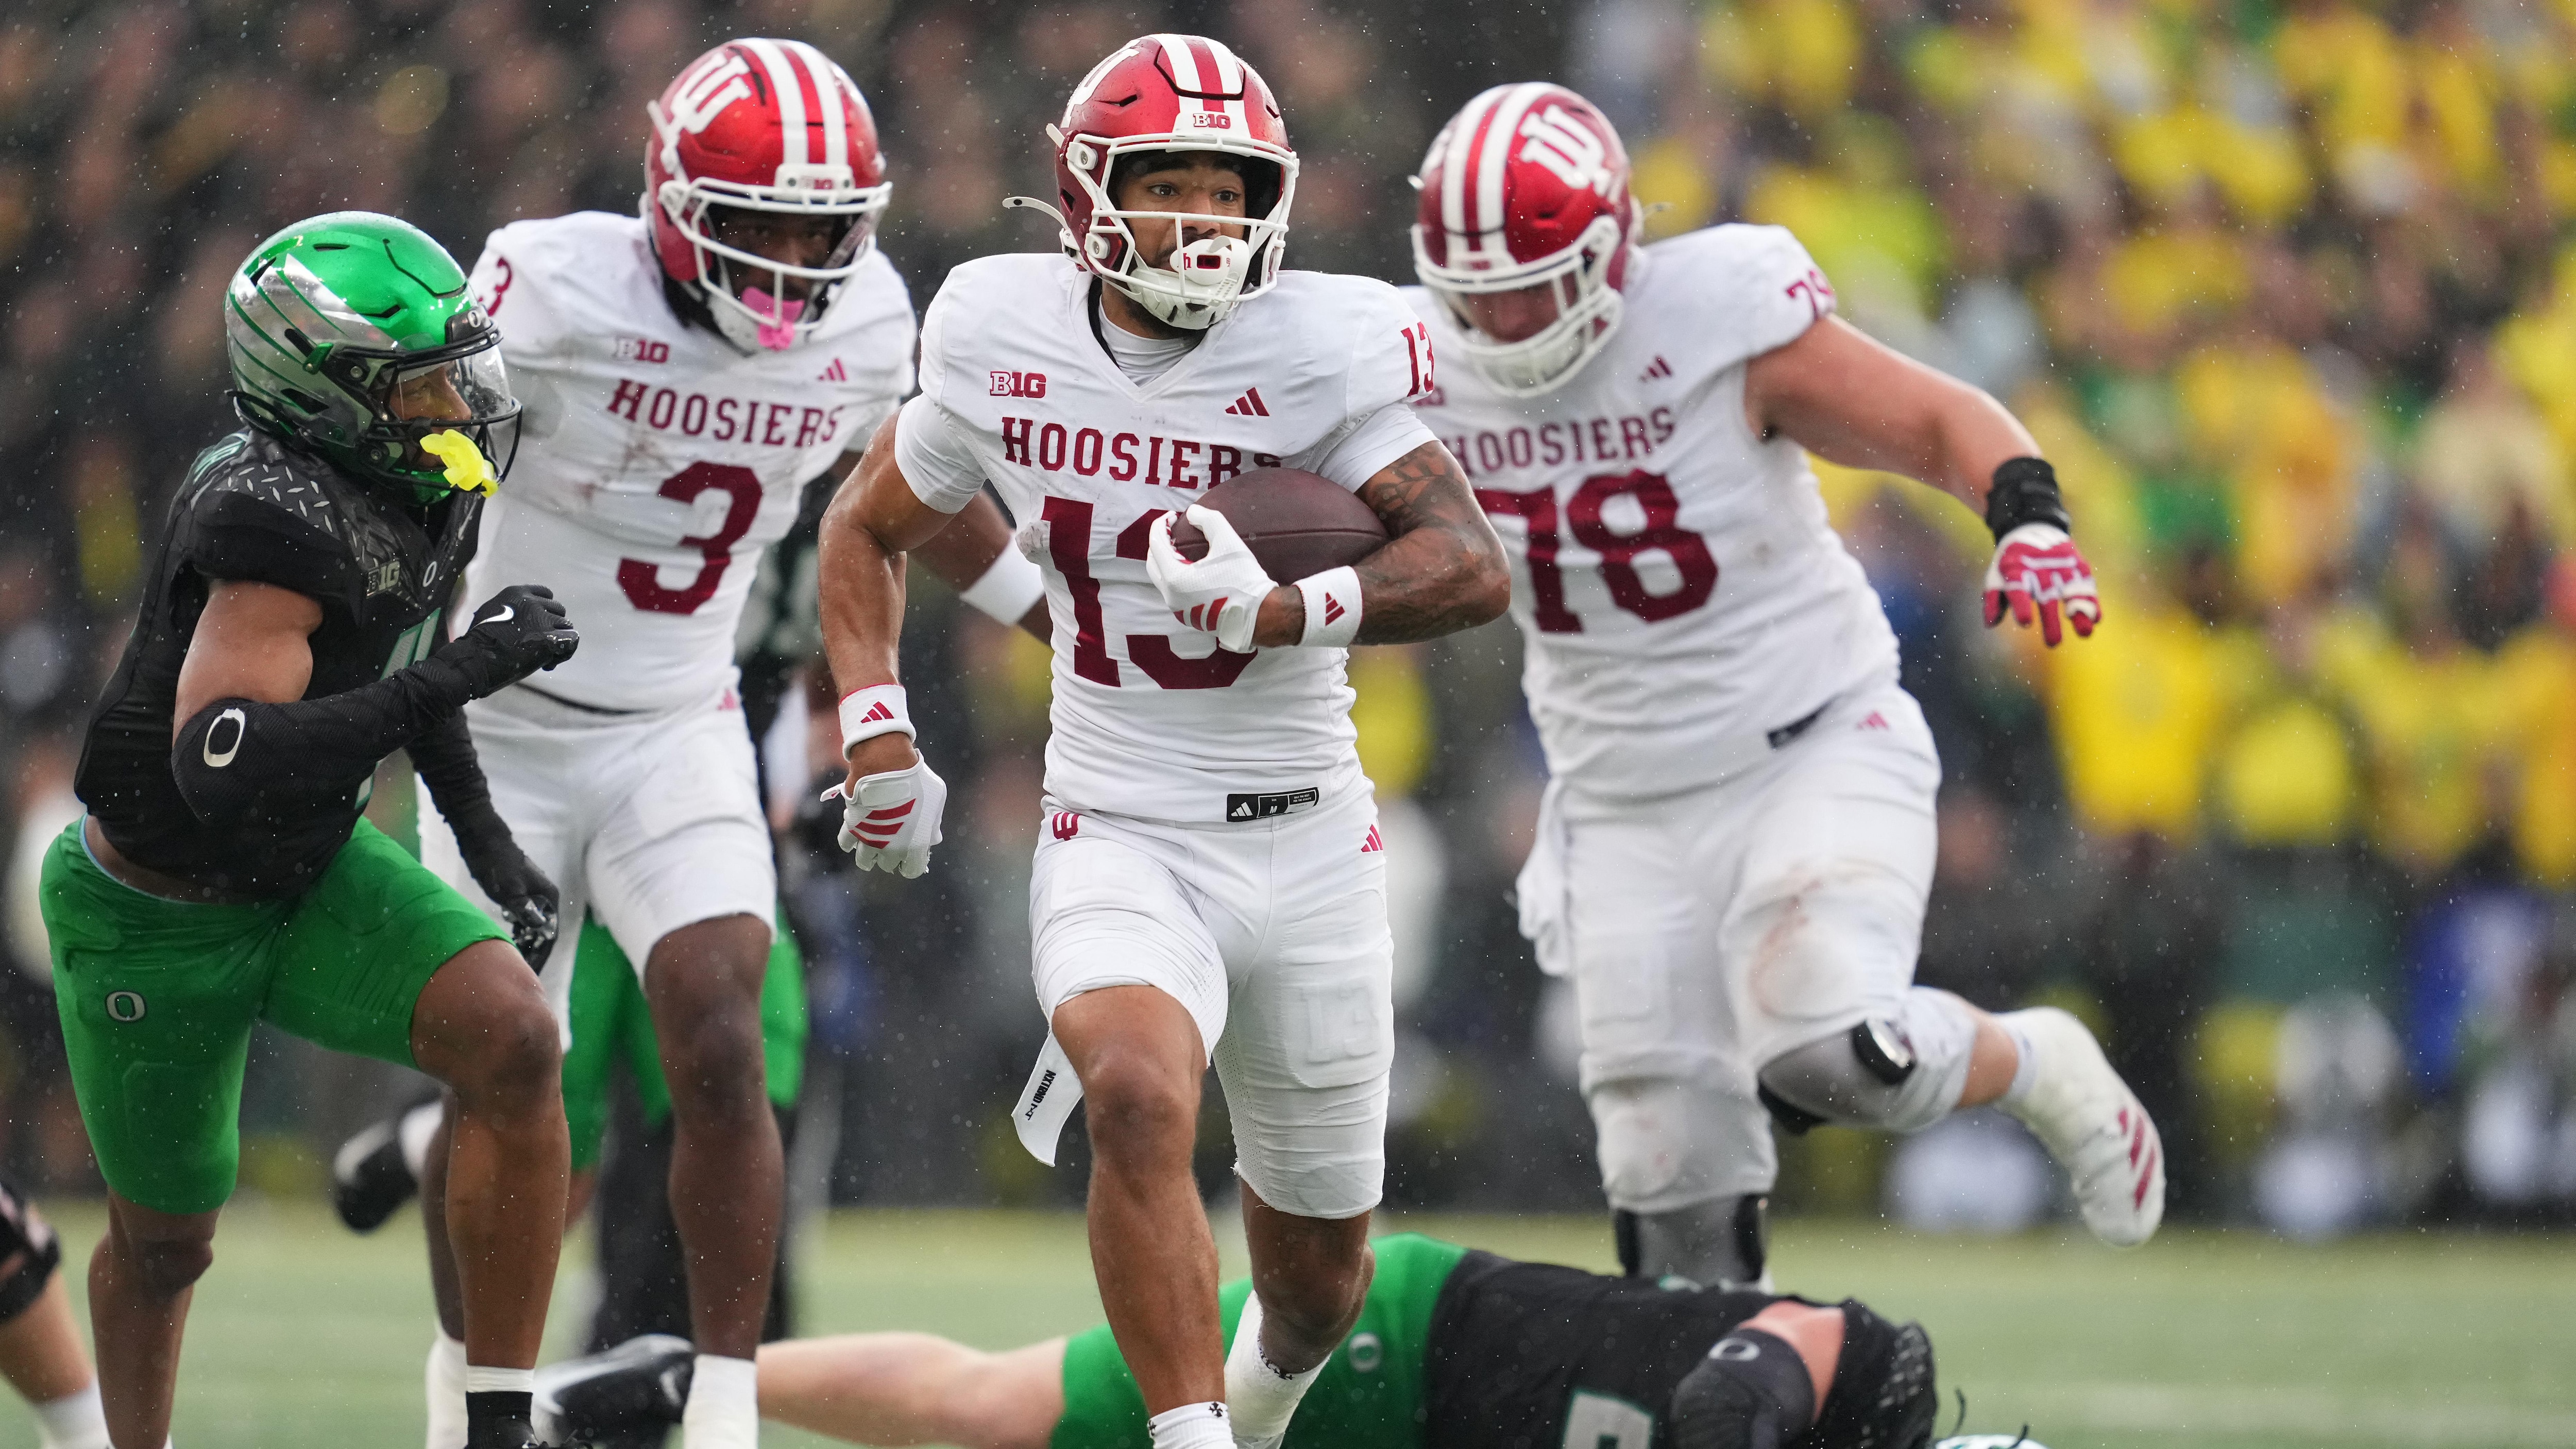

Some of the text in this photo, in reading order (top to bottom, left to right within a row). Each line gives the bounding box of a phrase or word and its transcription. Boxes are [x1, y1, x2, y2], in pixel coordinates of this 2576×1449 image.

[606, 377, 845, 447] HOOSIERS
[1400, 321, 1435, 397] 13
[615, 461, 764, 616] 3
[1472, 468, 1719, 635] 78
